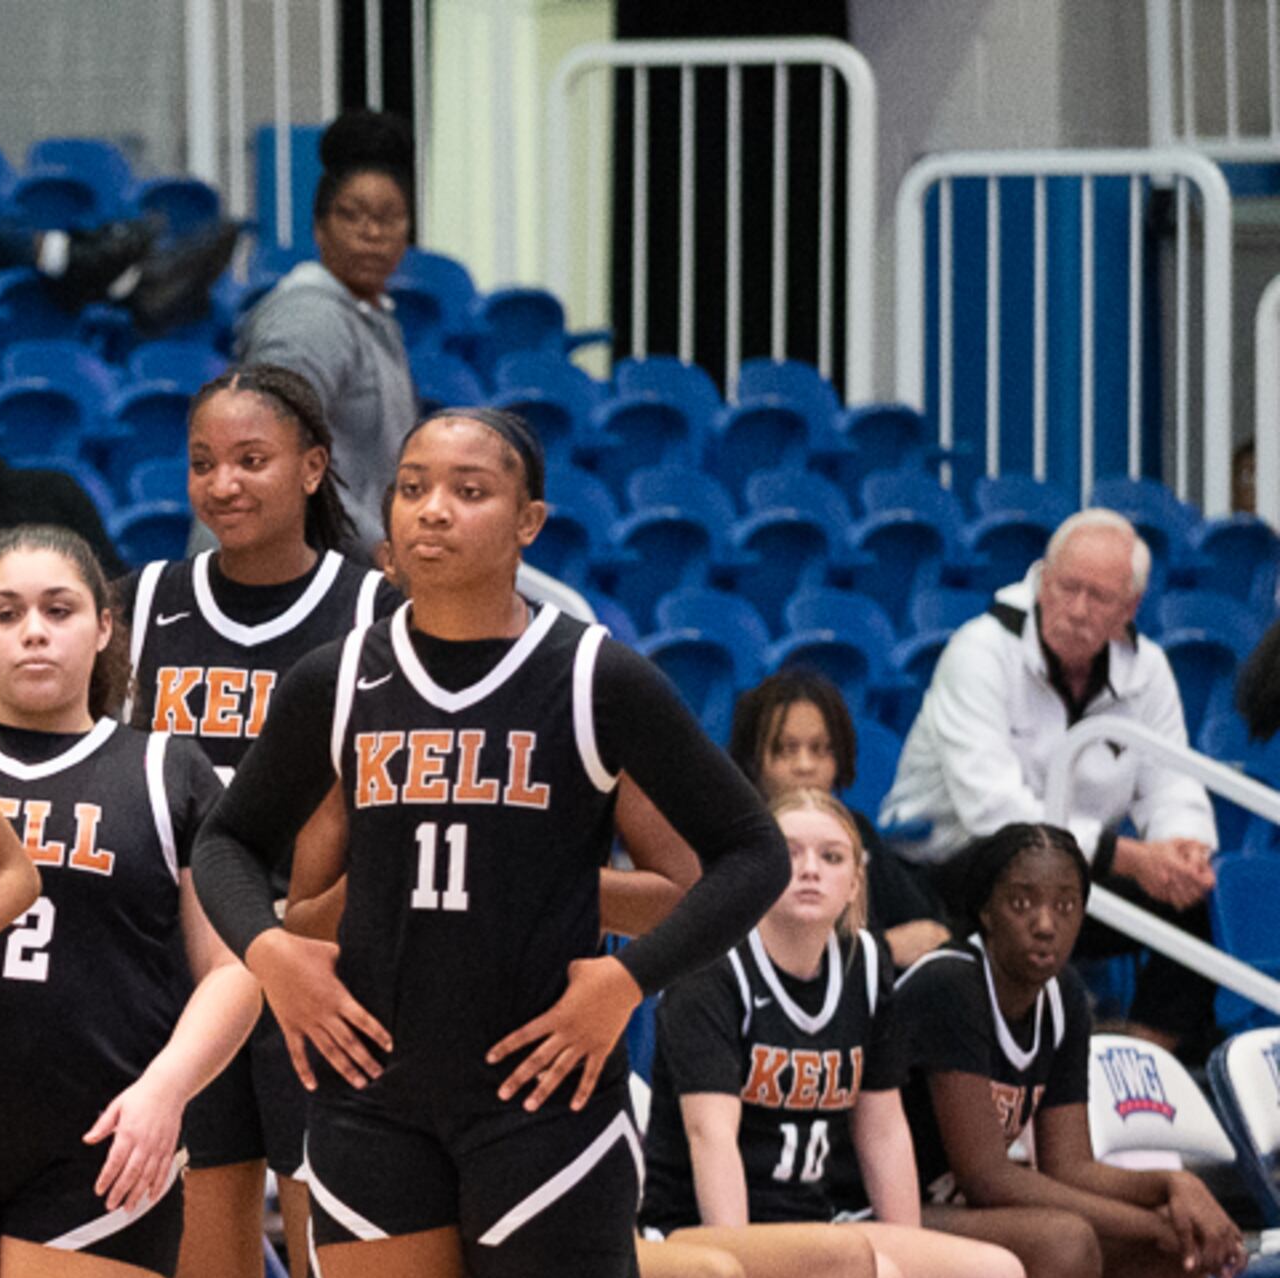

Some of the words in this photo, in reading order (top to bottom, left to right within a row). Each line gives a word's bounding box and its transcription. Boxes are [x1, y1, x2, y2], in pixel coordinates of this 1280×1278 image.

[152, 666, 277, 738] KEL
[354, 729, 550, 808] KELL
[411, 822, 469, 911] 11
[771, 1119, 831, 1182] 10
